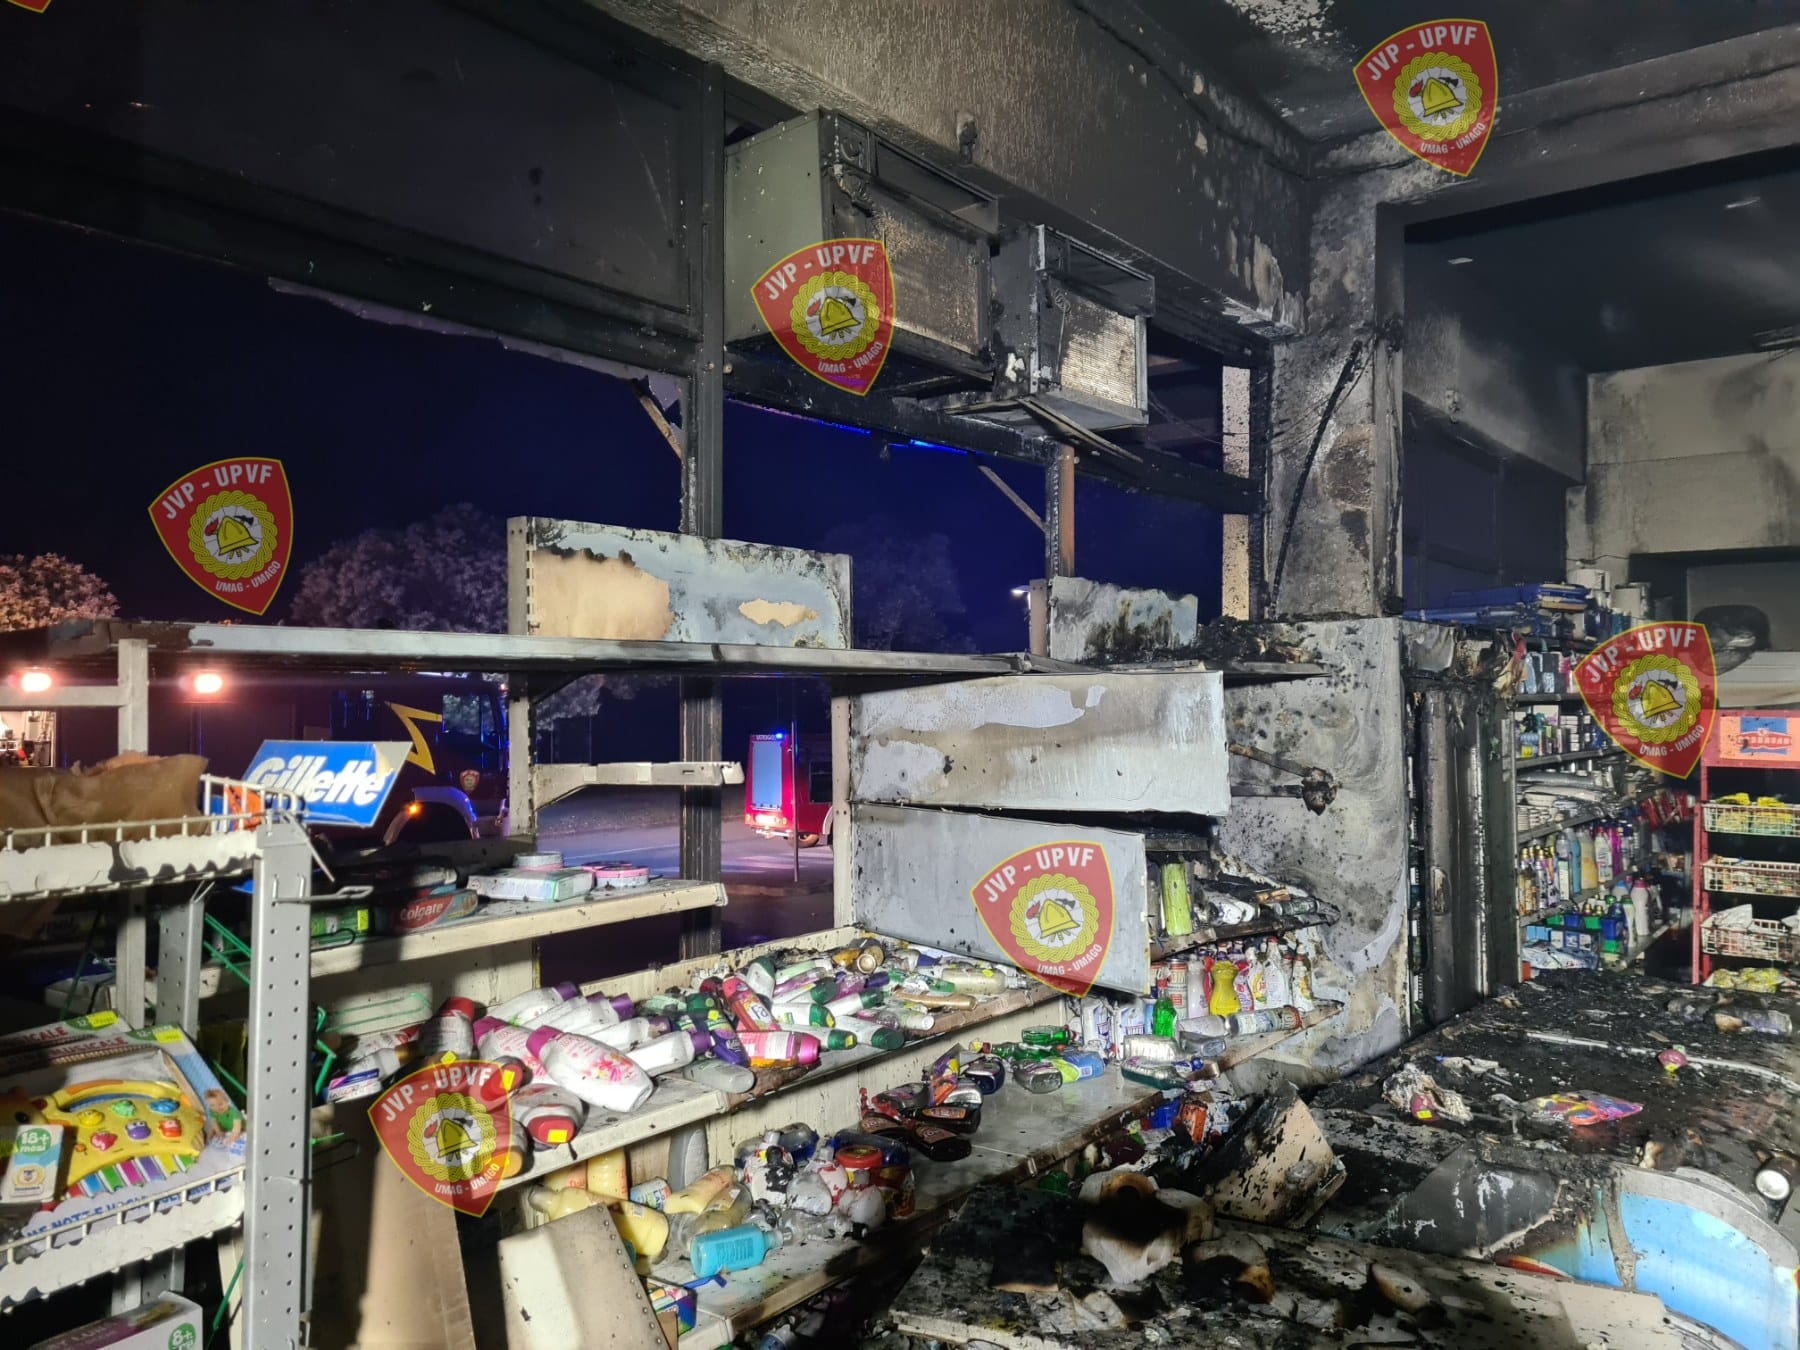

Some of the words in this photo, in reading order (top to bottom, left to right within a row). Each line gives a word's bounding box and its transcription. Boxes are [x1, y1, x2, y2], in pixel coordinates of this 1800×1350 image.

[247, 755, 393, 806] Gillette
[400, 902, 444, 921] Colgate
[751, 1005, 769, 1020] Fa
[20, 1131, 49, 1146] 18+
